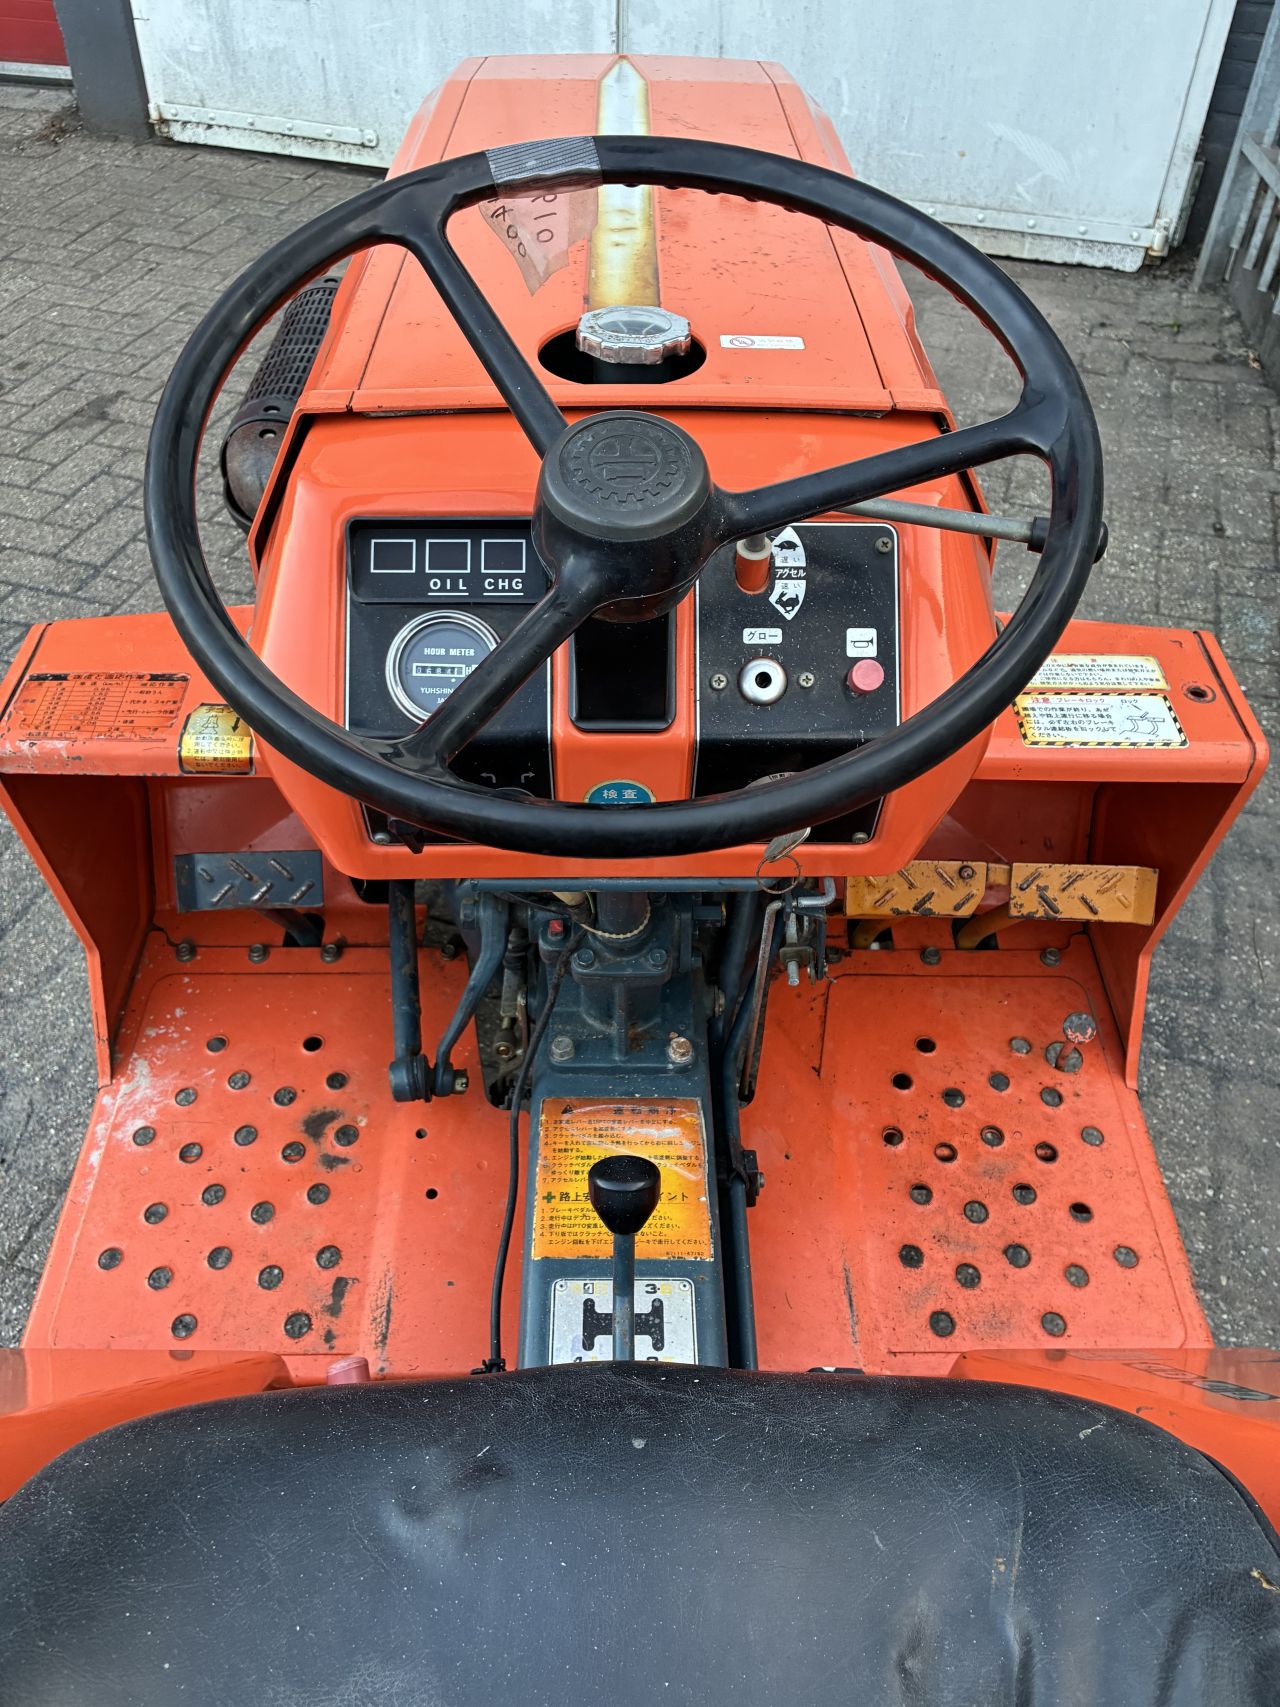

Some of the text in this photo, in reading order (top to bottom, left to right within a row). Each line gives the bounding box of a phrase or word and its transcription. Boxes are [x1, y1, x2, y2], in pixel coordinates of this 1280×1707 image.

[429, 578, 468, 590] OIL
[484, 578, 523, 590] CHG
[747, 630, 778, 642] グロー
[602, 789, 638, 799] 検査
